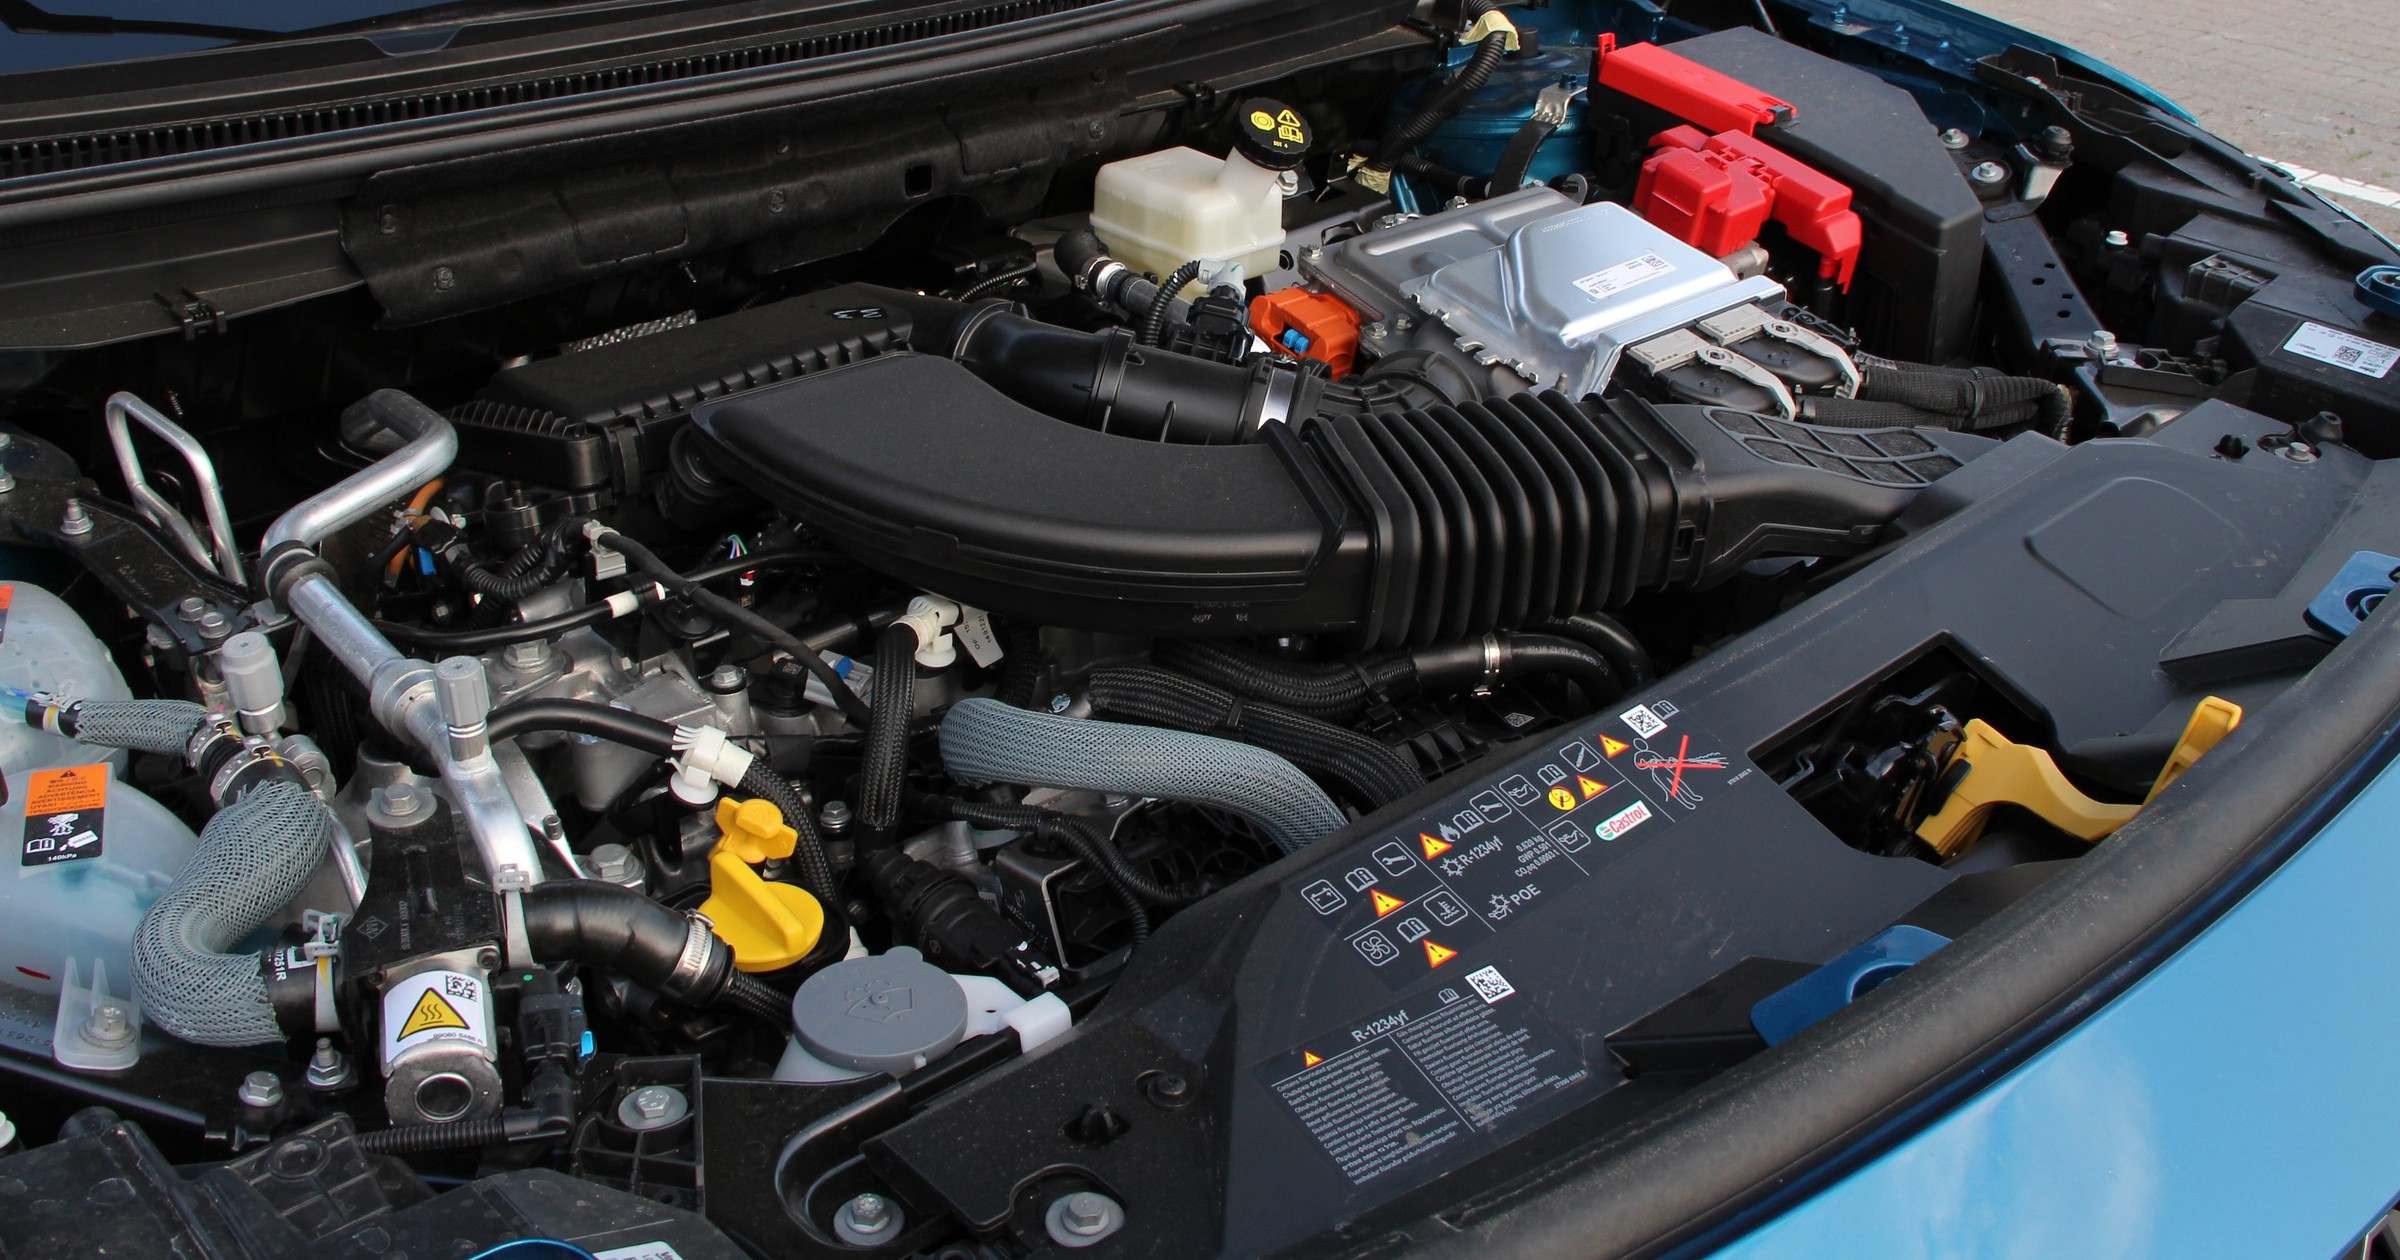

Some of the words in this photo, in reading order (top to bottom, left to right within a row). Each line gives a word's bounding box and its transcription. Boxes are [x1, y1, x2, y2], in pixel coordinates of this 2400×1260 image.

[1609, 804, 1647, 834] Castrol
[1458, 836, 1504, 867] R-1234yf
[1517, 849, 1535, 864] GWP
[1510, 883, 1541, 906] POE
[1351, 1010, 1409, 1042] R-1234yf
